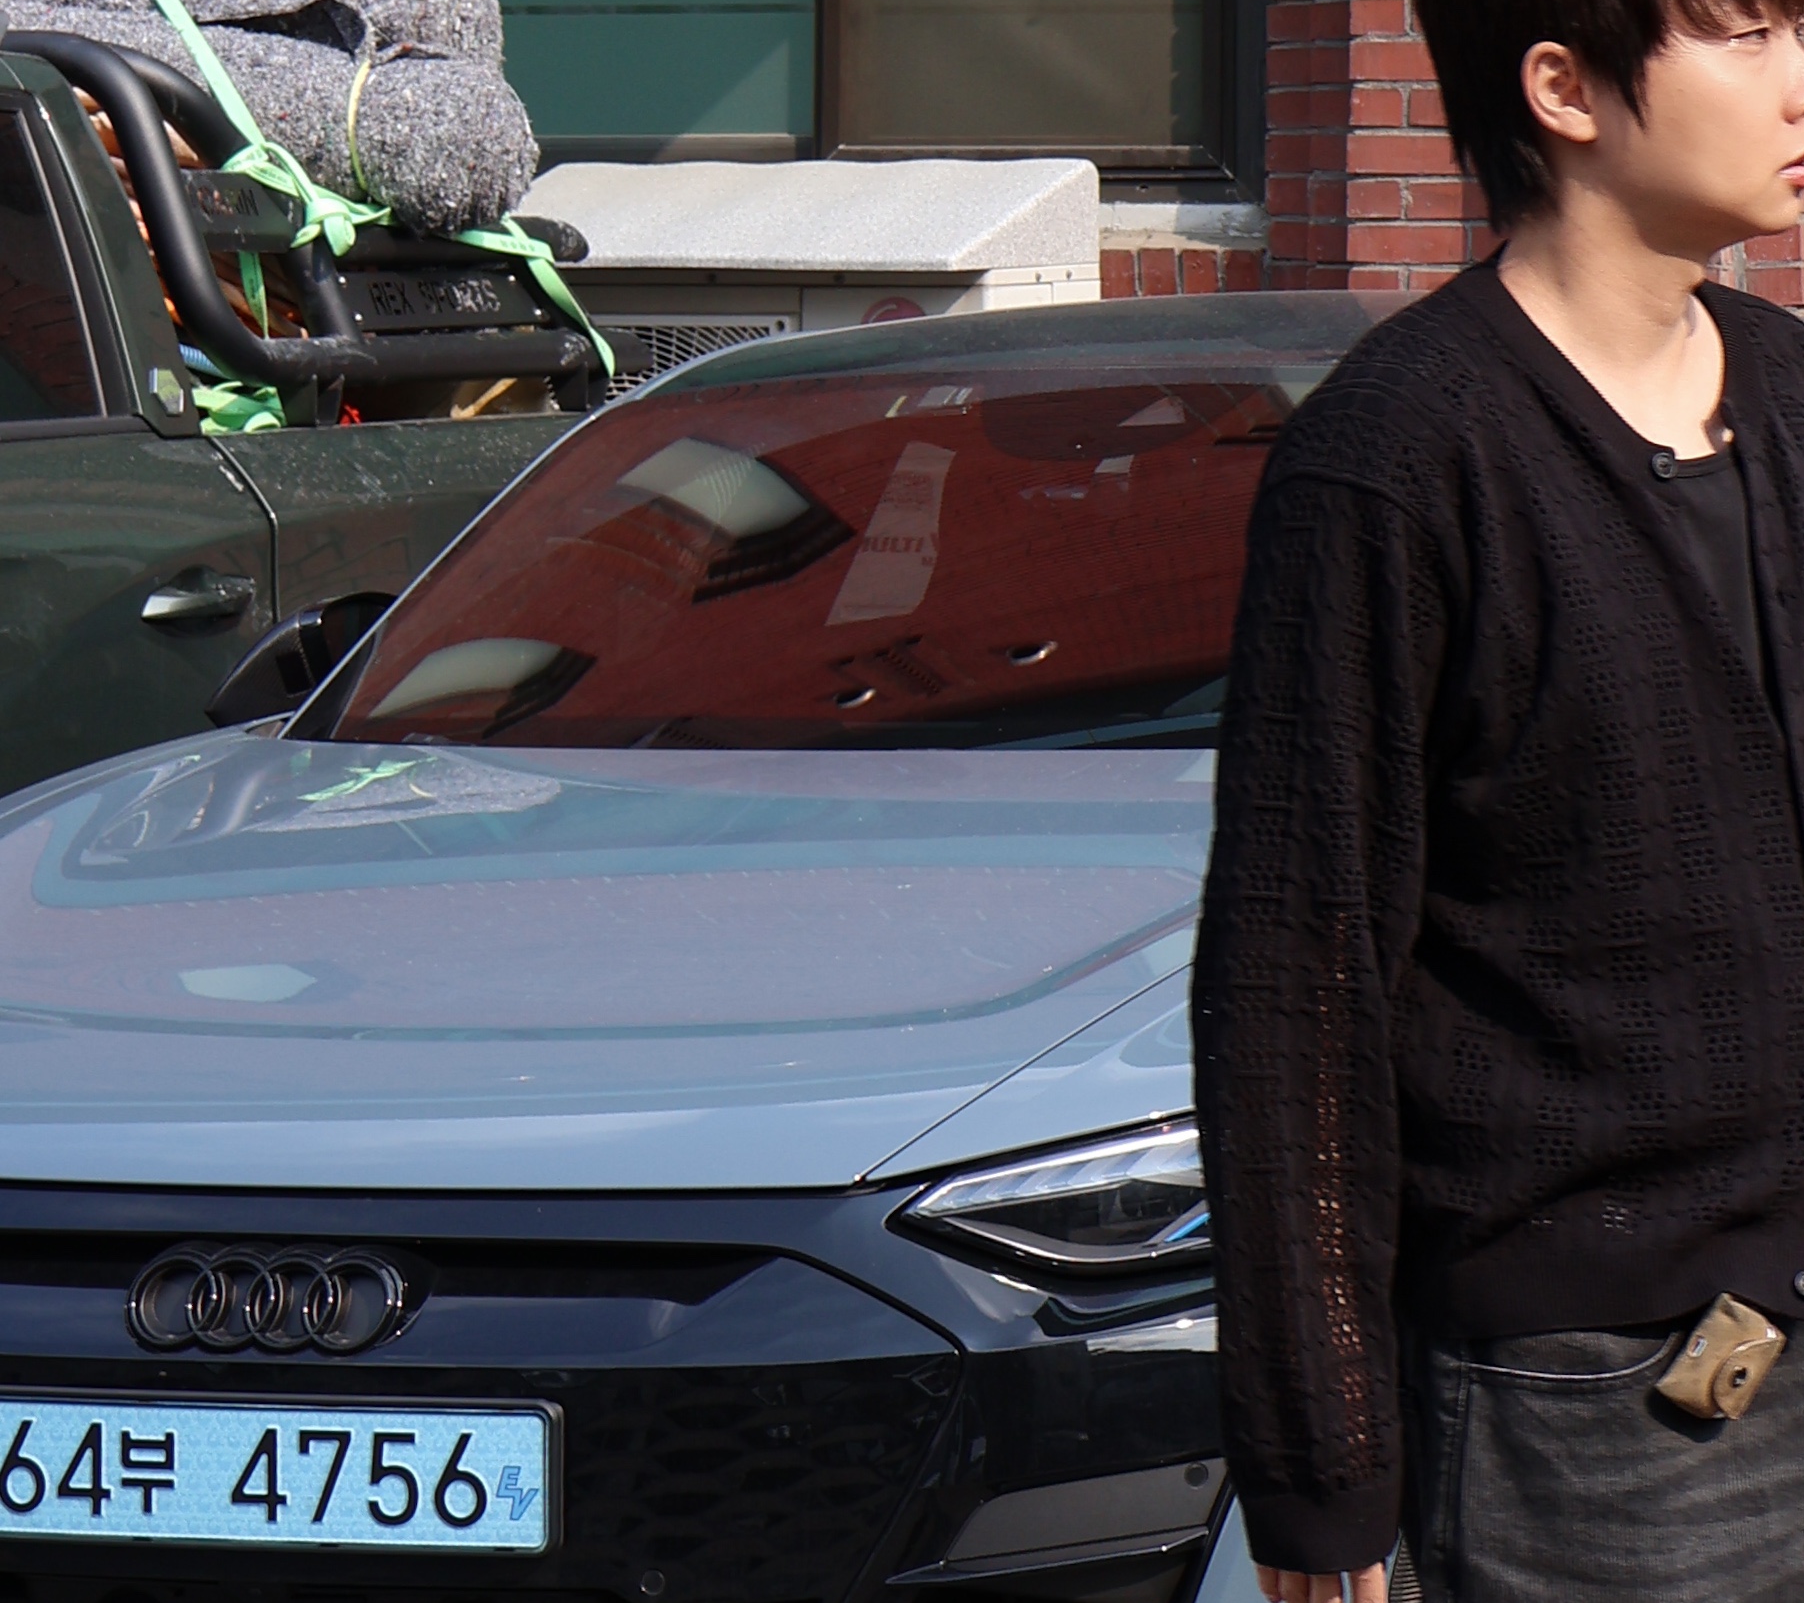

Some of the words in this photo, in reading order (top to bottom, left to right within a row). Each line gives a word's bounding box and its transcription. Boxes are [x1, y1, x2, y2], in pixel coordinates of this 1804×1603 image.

[368, 281, 415, 316] REX
[418, 278, 501, 314] SPORTS
[1, 1419, 176, 1517] 64부
[230, 1427, 489, 1528] 4756
[496, 1465, 539, 1522] EV
